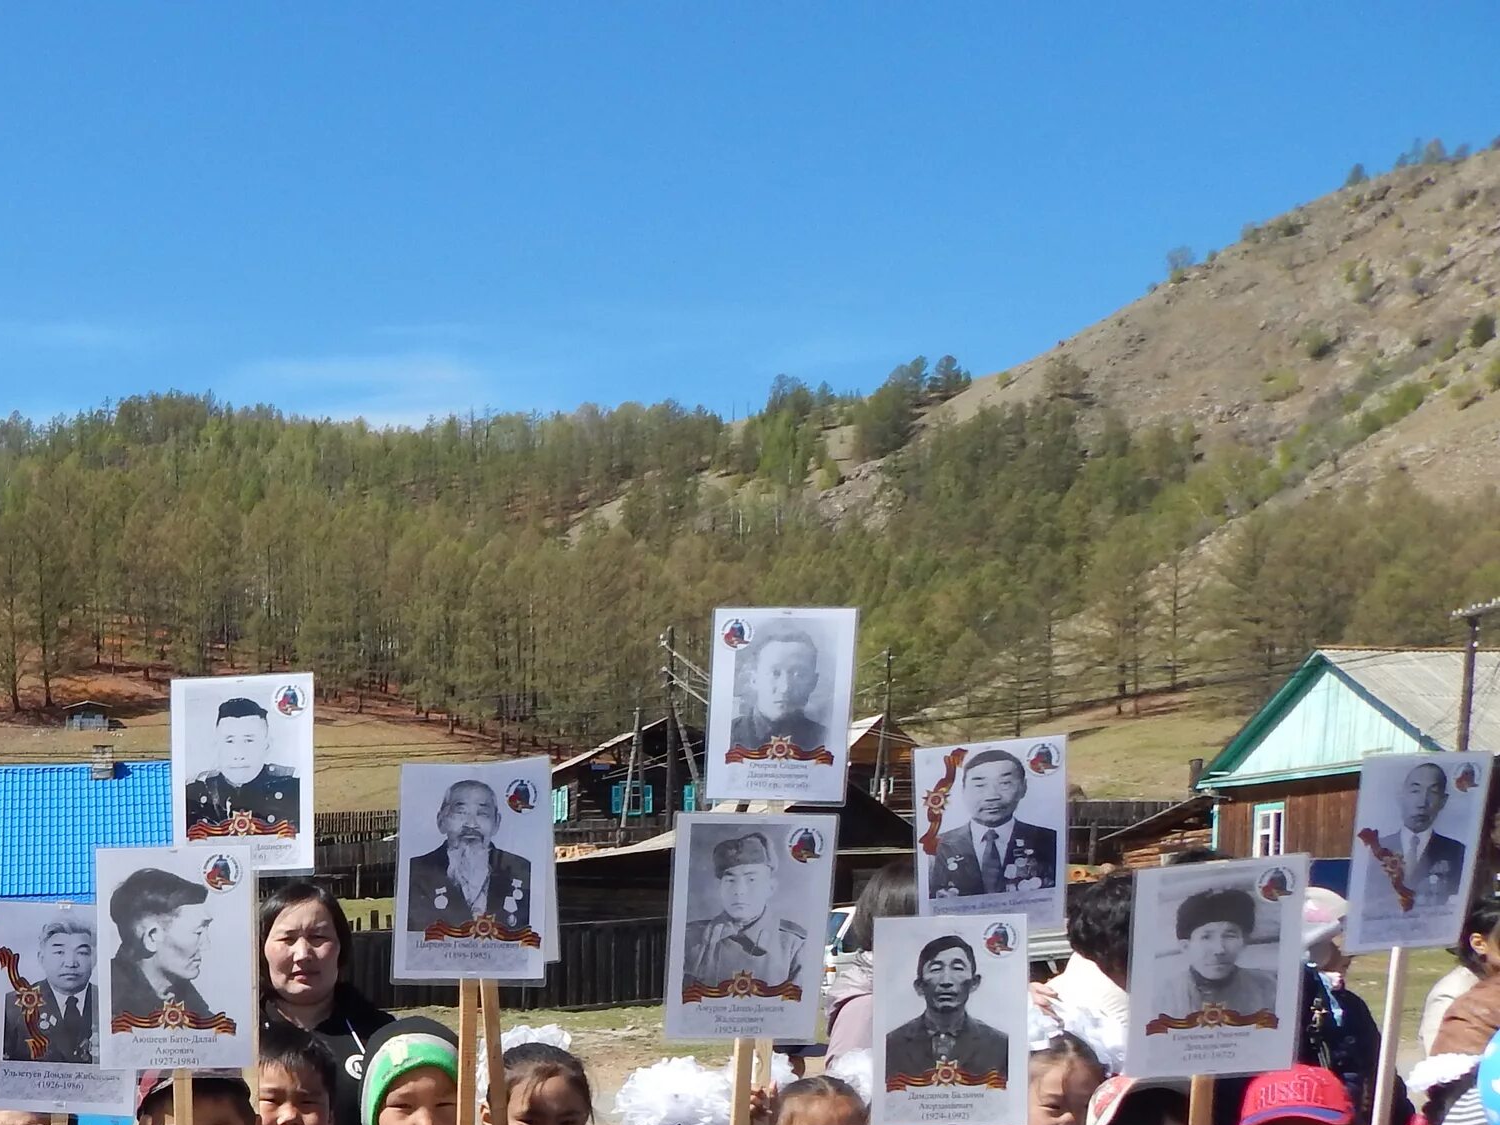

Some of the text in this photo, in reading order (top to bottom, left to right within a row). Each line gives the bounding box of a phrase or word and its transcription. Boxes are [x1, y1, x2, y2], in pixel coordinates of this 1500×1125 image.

[132, 1033, 218, 1045] Аюшеев Бато-Далай
[155, 1047, 194, 1056] Аюрович
[150, 1057, 200, 1066] (1927-1984)
